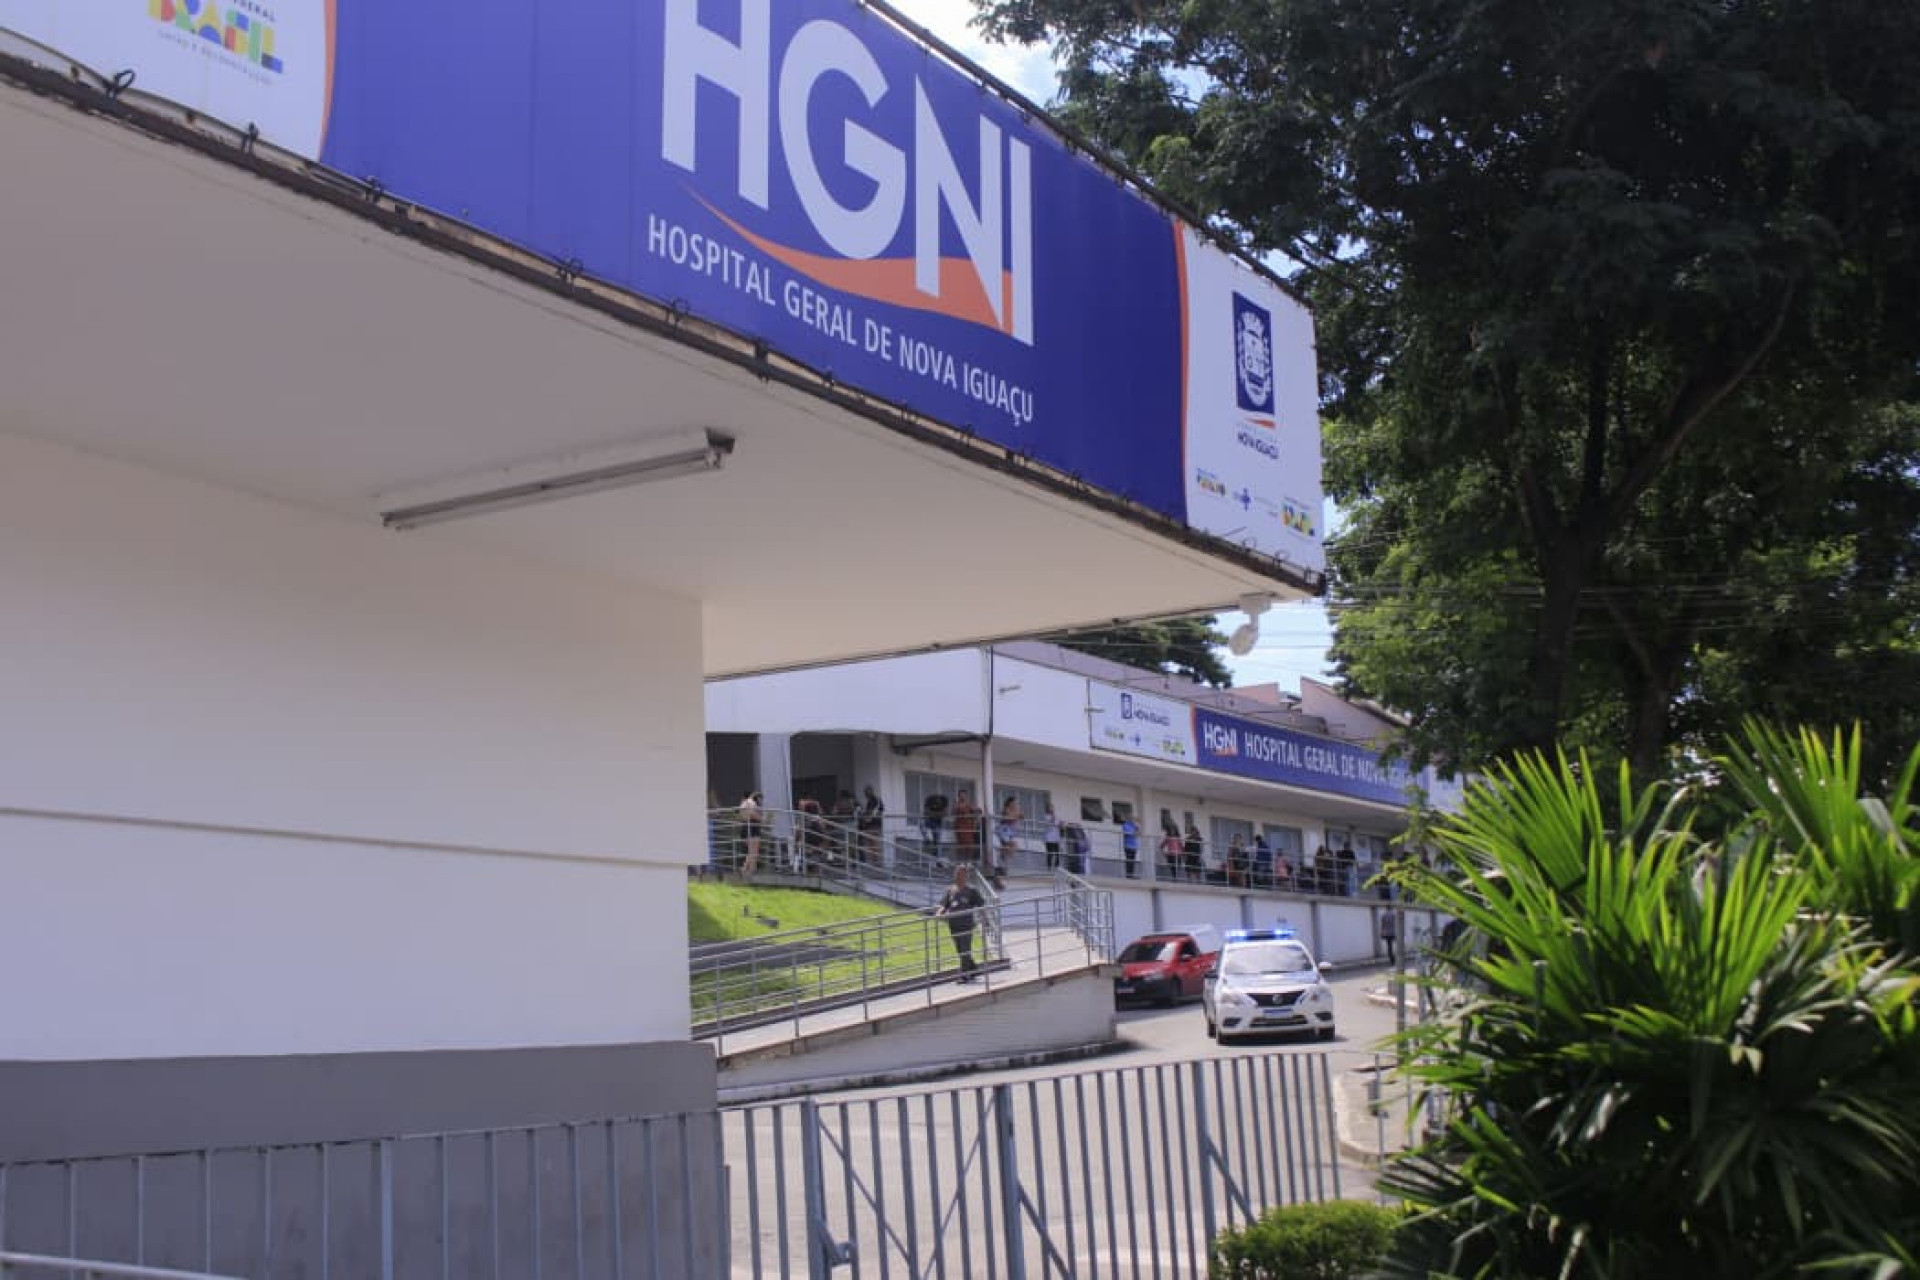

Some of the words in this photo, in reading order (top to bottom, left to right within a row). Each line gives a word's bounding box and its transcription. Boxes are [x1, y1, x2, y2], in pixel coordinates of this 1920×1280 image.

[661, 0, 1034, 347] HGNI
[648, 212, 777, 307] HOSPITAL
[784, 279, 858, 346] GERAL
[864, 317, 893, 362] DE
[900, 335, 958, 390] NOVA
[963, 362, 1034, 427] IGUAÇU
[1203, 719, 1238, 756] HGNI
[1244, 730, 1303, 769] HOSPITAL
[1303, 745, 1340, 777] GERAL
[1341, 754, 1356, 780] DE
